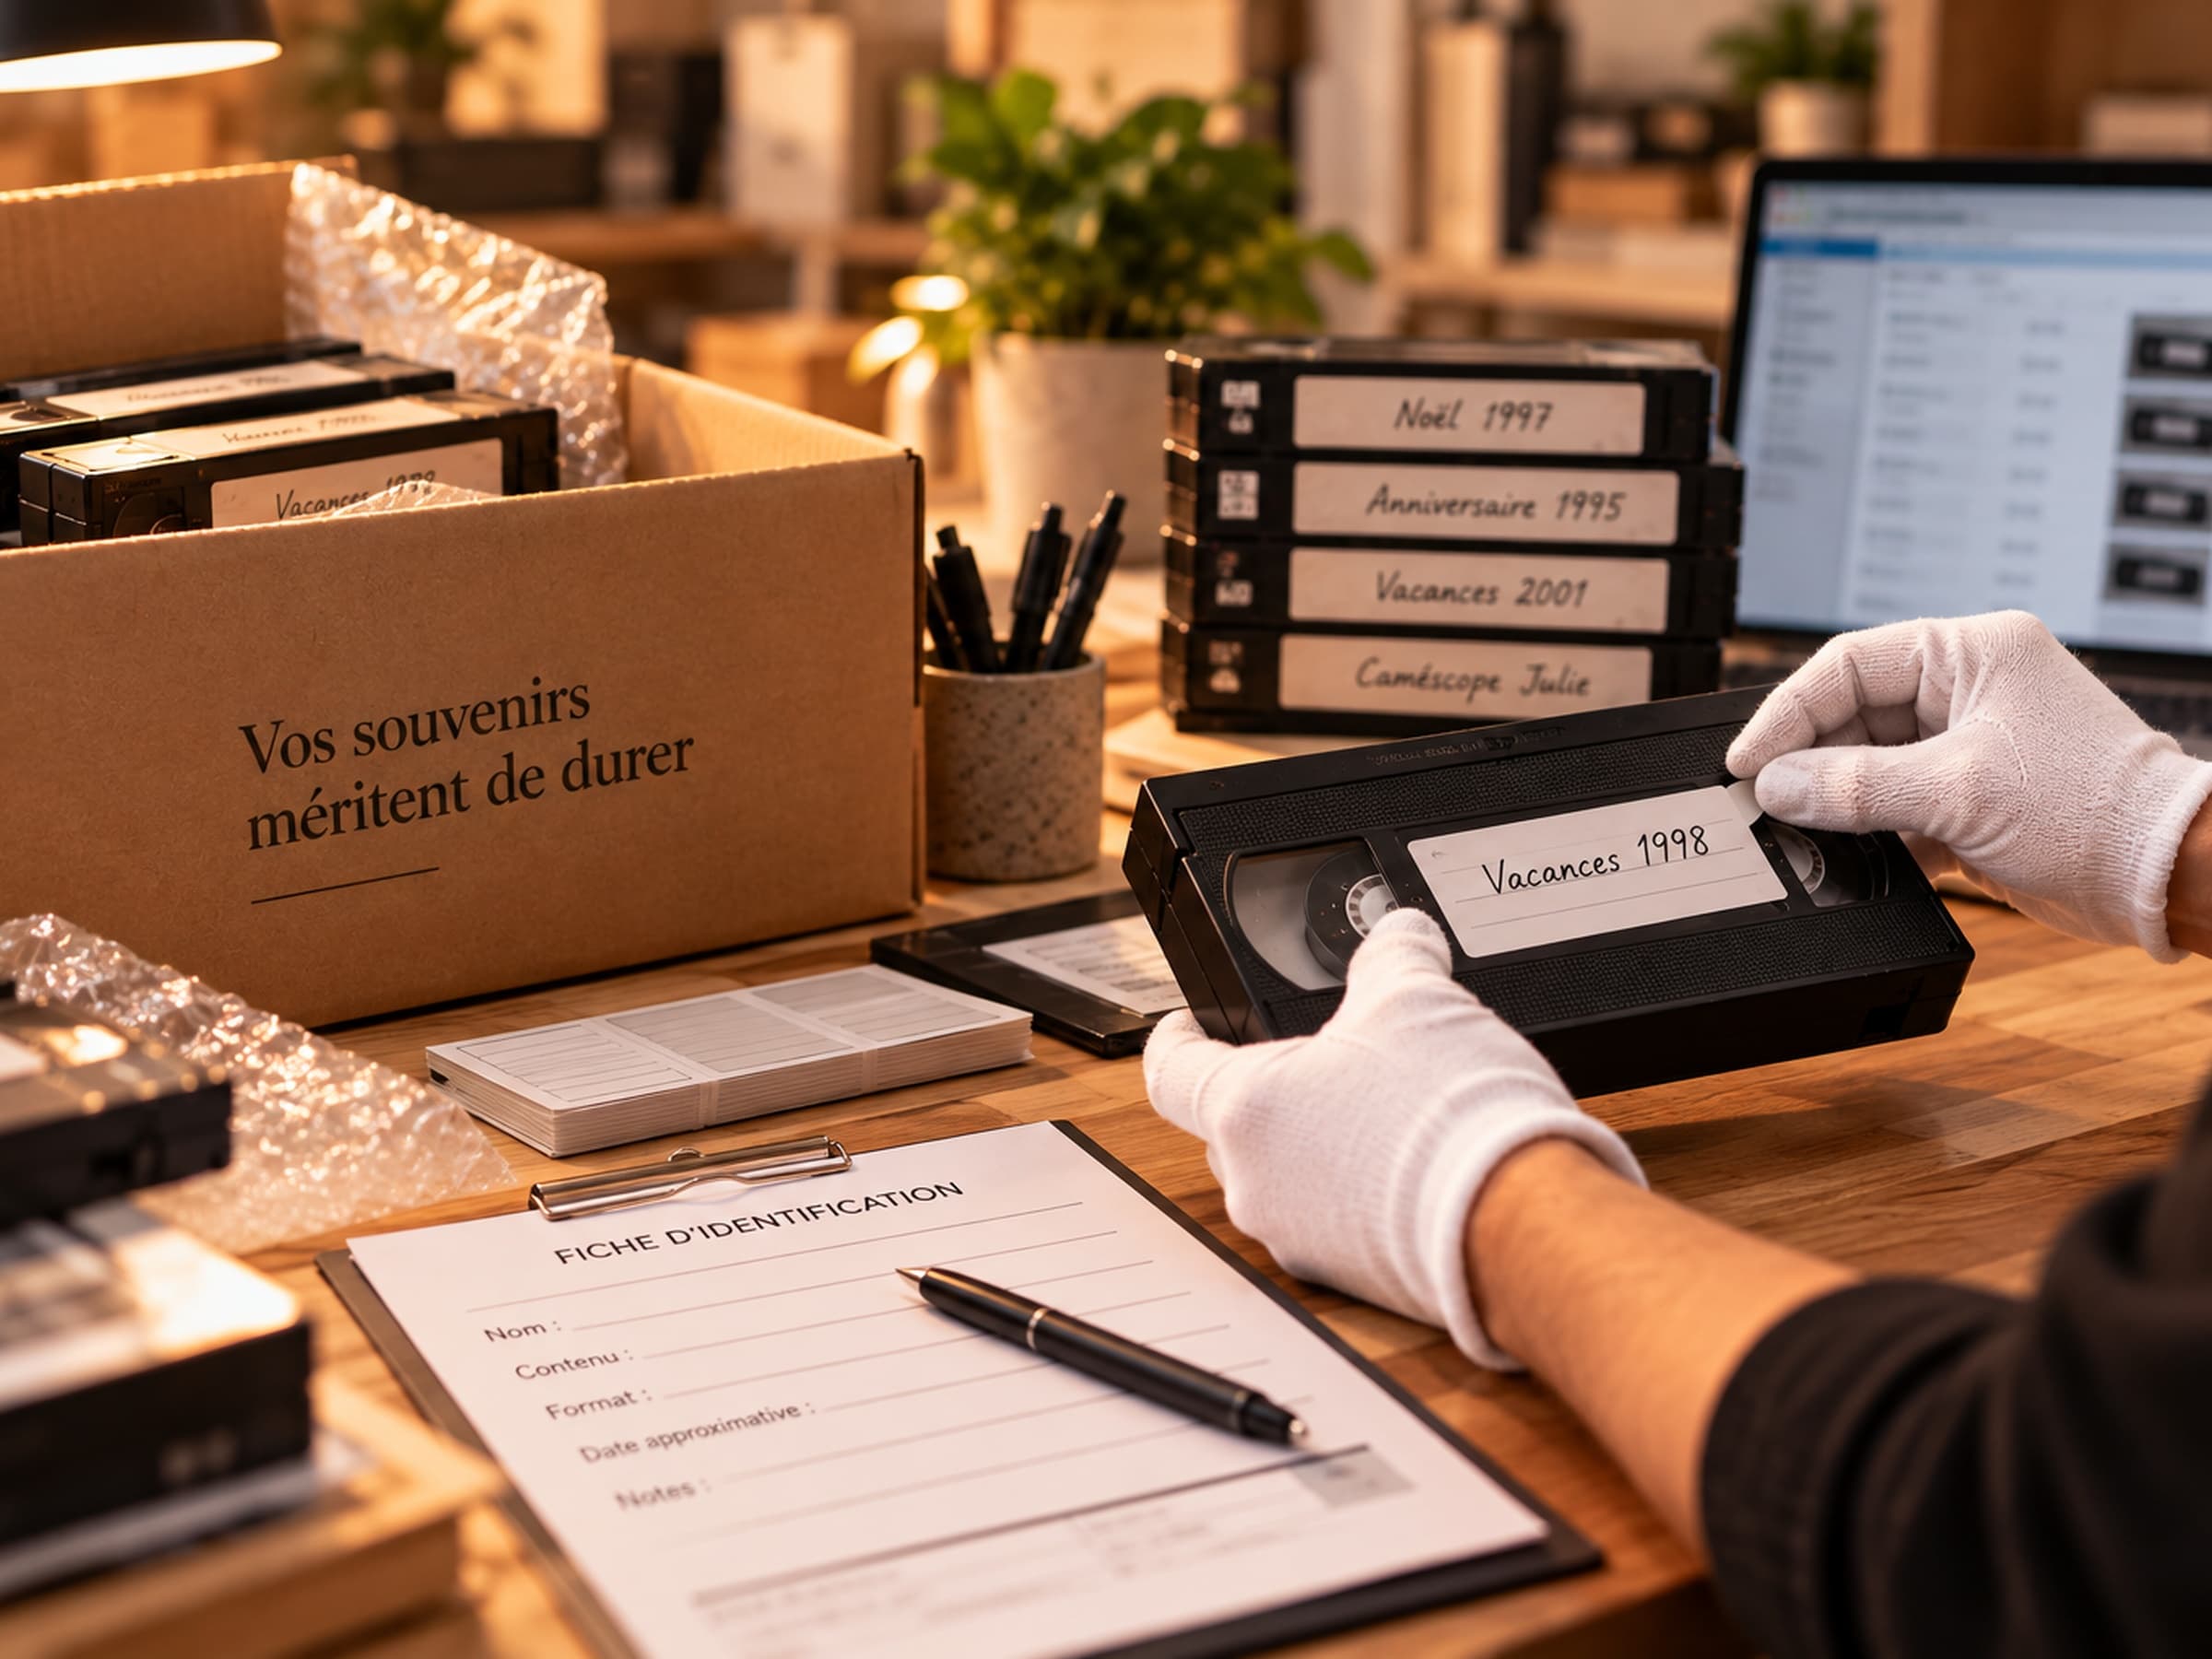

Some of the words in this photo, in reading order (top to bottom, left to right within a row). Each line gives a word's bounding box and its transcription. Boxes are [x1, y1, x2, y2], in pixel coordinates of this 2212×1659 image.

[1394, 398, 1464, 430] Noël
[1483, 400, 1554, 431] 1997
[1365, 483, 1537, 519] Anniversaire
[1556, 489, 1627, 523] 1995
[1375, 570, 1500, 606] Vacances
[1513, 576, 1589, 608] 2001
[1354, 656, 1501, 701] Caméscope
[1519, 662, 1592, 698] Julie
[238, 719, 336, 774] Vos
[352, 676, 592, 759] souvenirs
[247, 779, 471, 852] méritent
[486, 751, 547, 807] de
[561, 736, 695, 793] durer
[1481, 853, 1621, 896] Vacances
[1636, 824, 1710, 869] 1998
[553, 1234, 660, 1265] FICHE
[665, 1181, 964, 1246] D'IDENTIFICATION
[484, 1324, 547, 1344] Nom
[514, 1348, 620, 1381] Contenu
[545, 1389, 638, 1420] Format
[579, 1440, 641, 1465] Date
[647, 1402, 802, 1450] approximative
[614, 1477, 696, 1512] Notes
